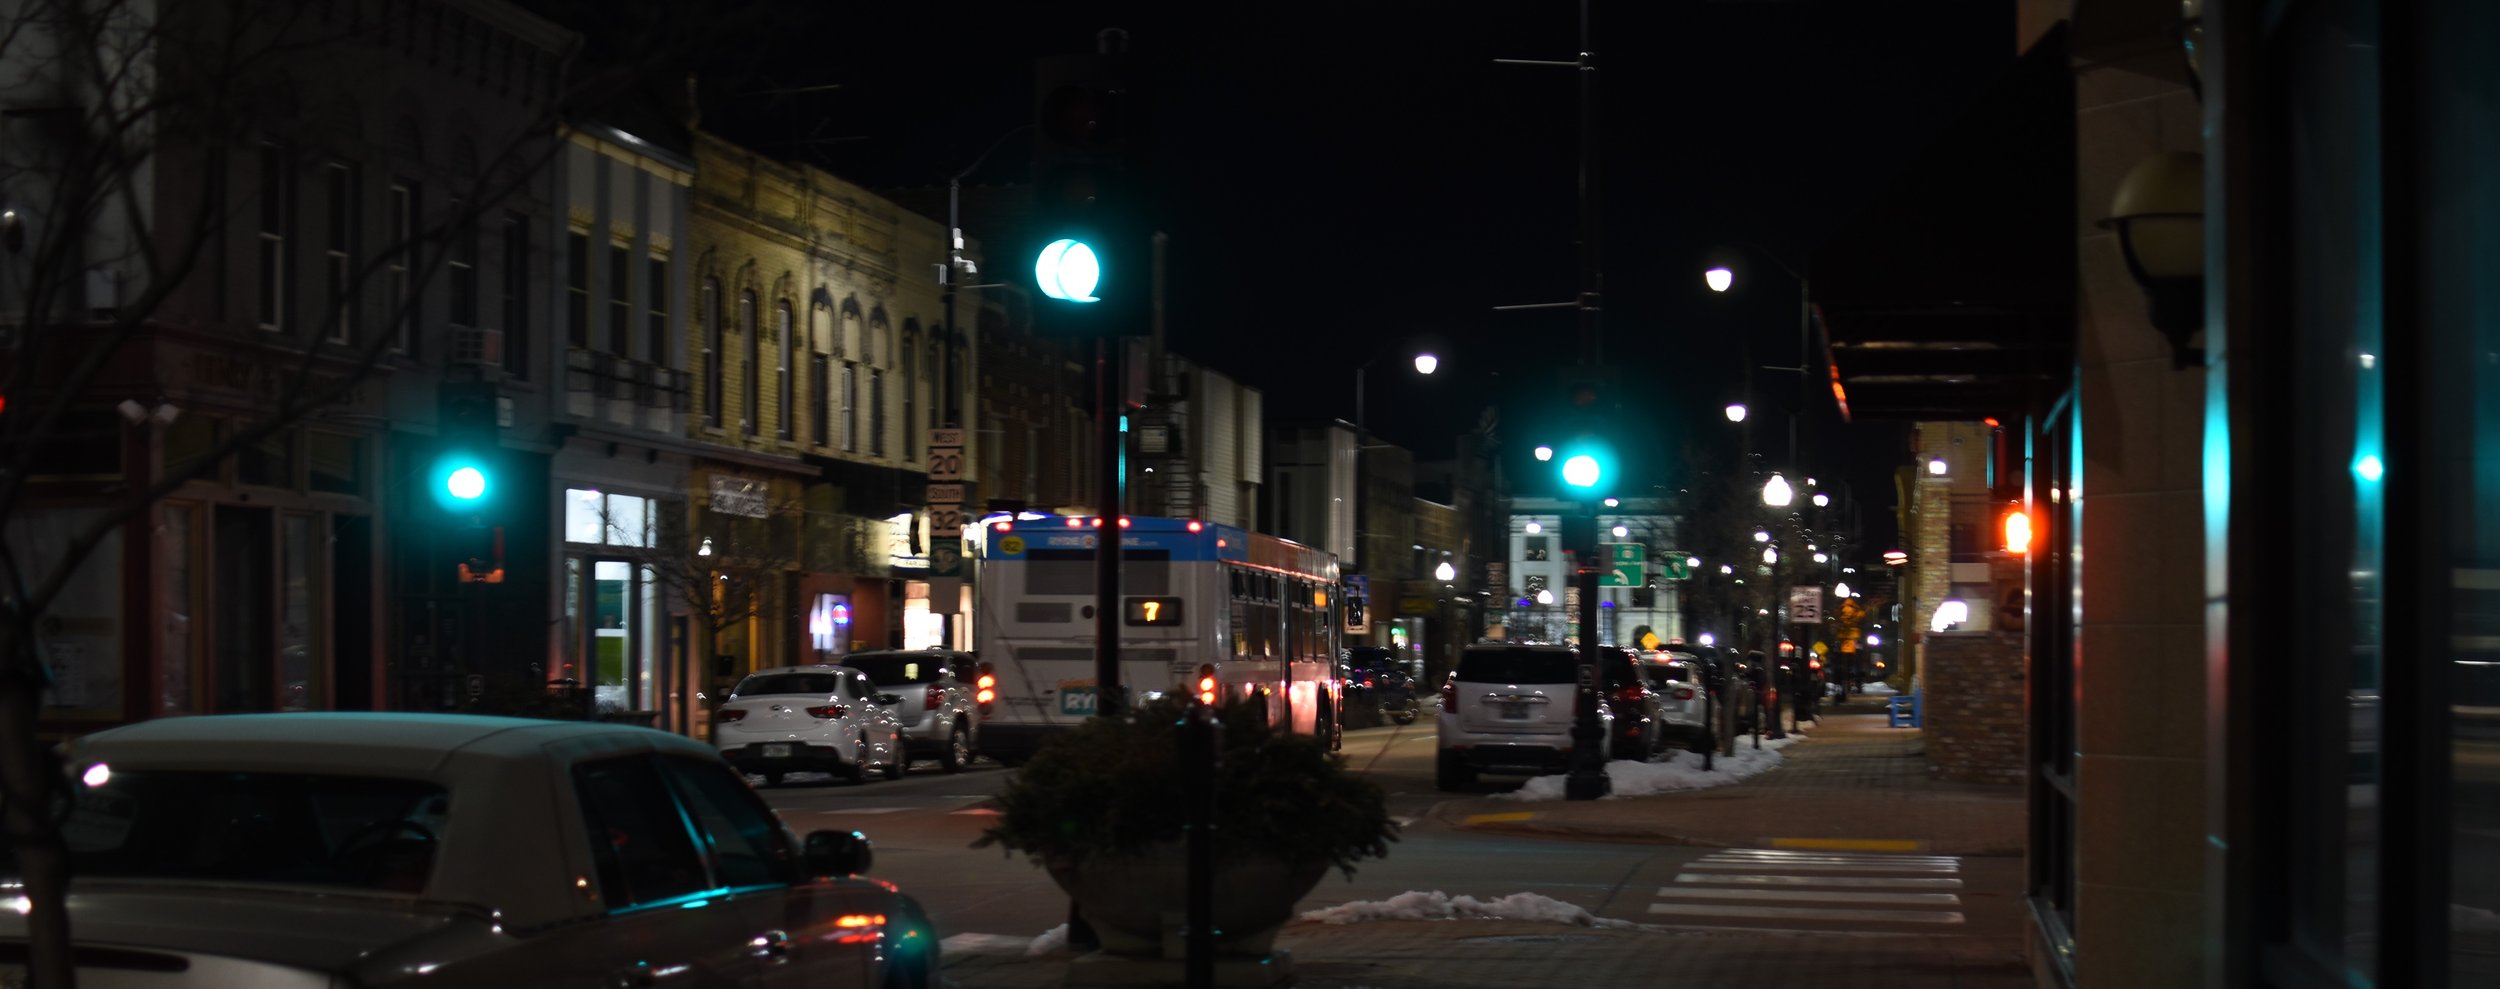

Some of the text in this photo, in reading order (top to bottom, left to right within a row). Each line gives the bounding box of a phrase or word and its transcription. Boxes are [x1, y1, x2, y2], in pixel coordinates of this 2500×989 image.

[931, 432, 960, 443] WEST
[930, 455, 960, 474] 20
[929, 488, 960, 499] SOUTH
[931, 511, 959, 530] 32
[1143, 602, 1160, 622] 7
[1794, 604, 1817, 618] 25
[1064, 692, 1098, 710] RY
